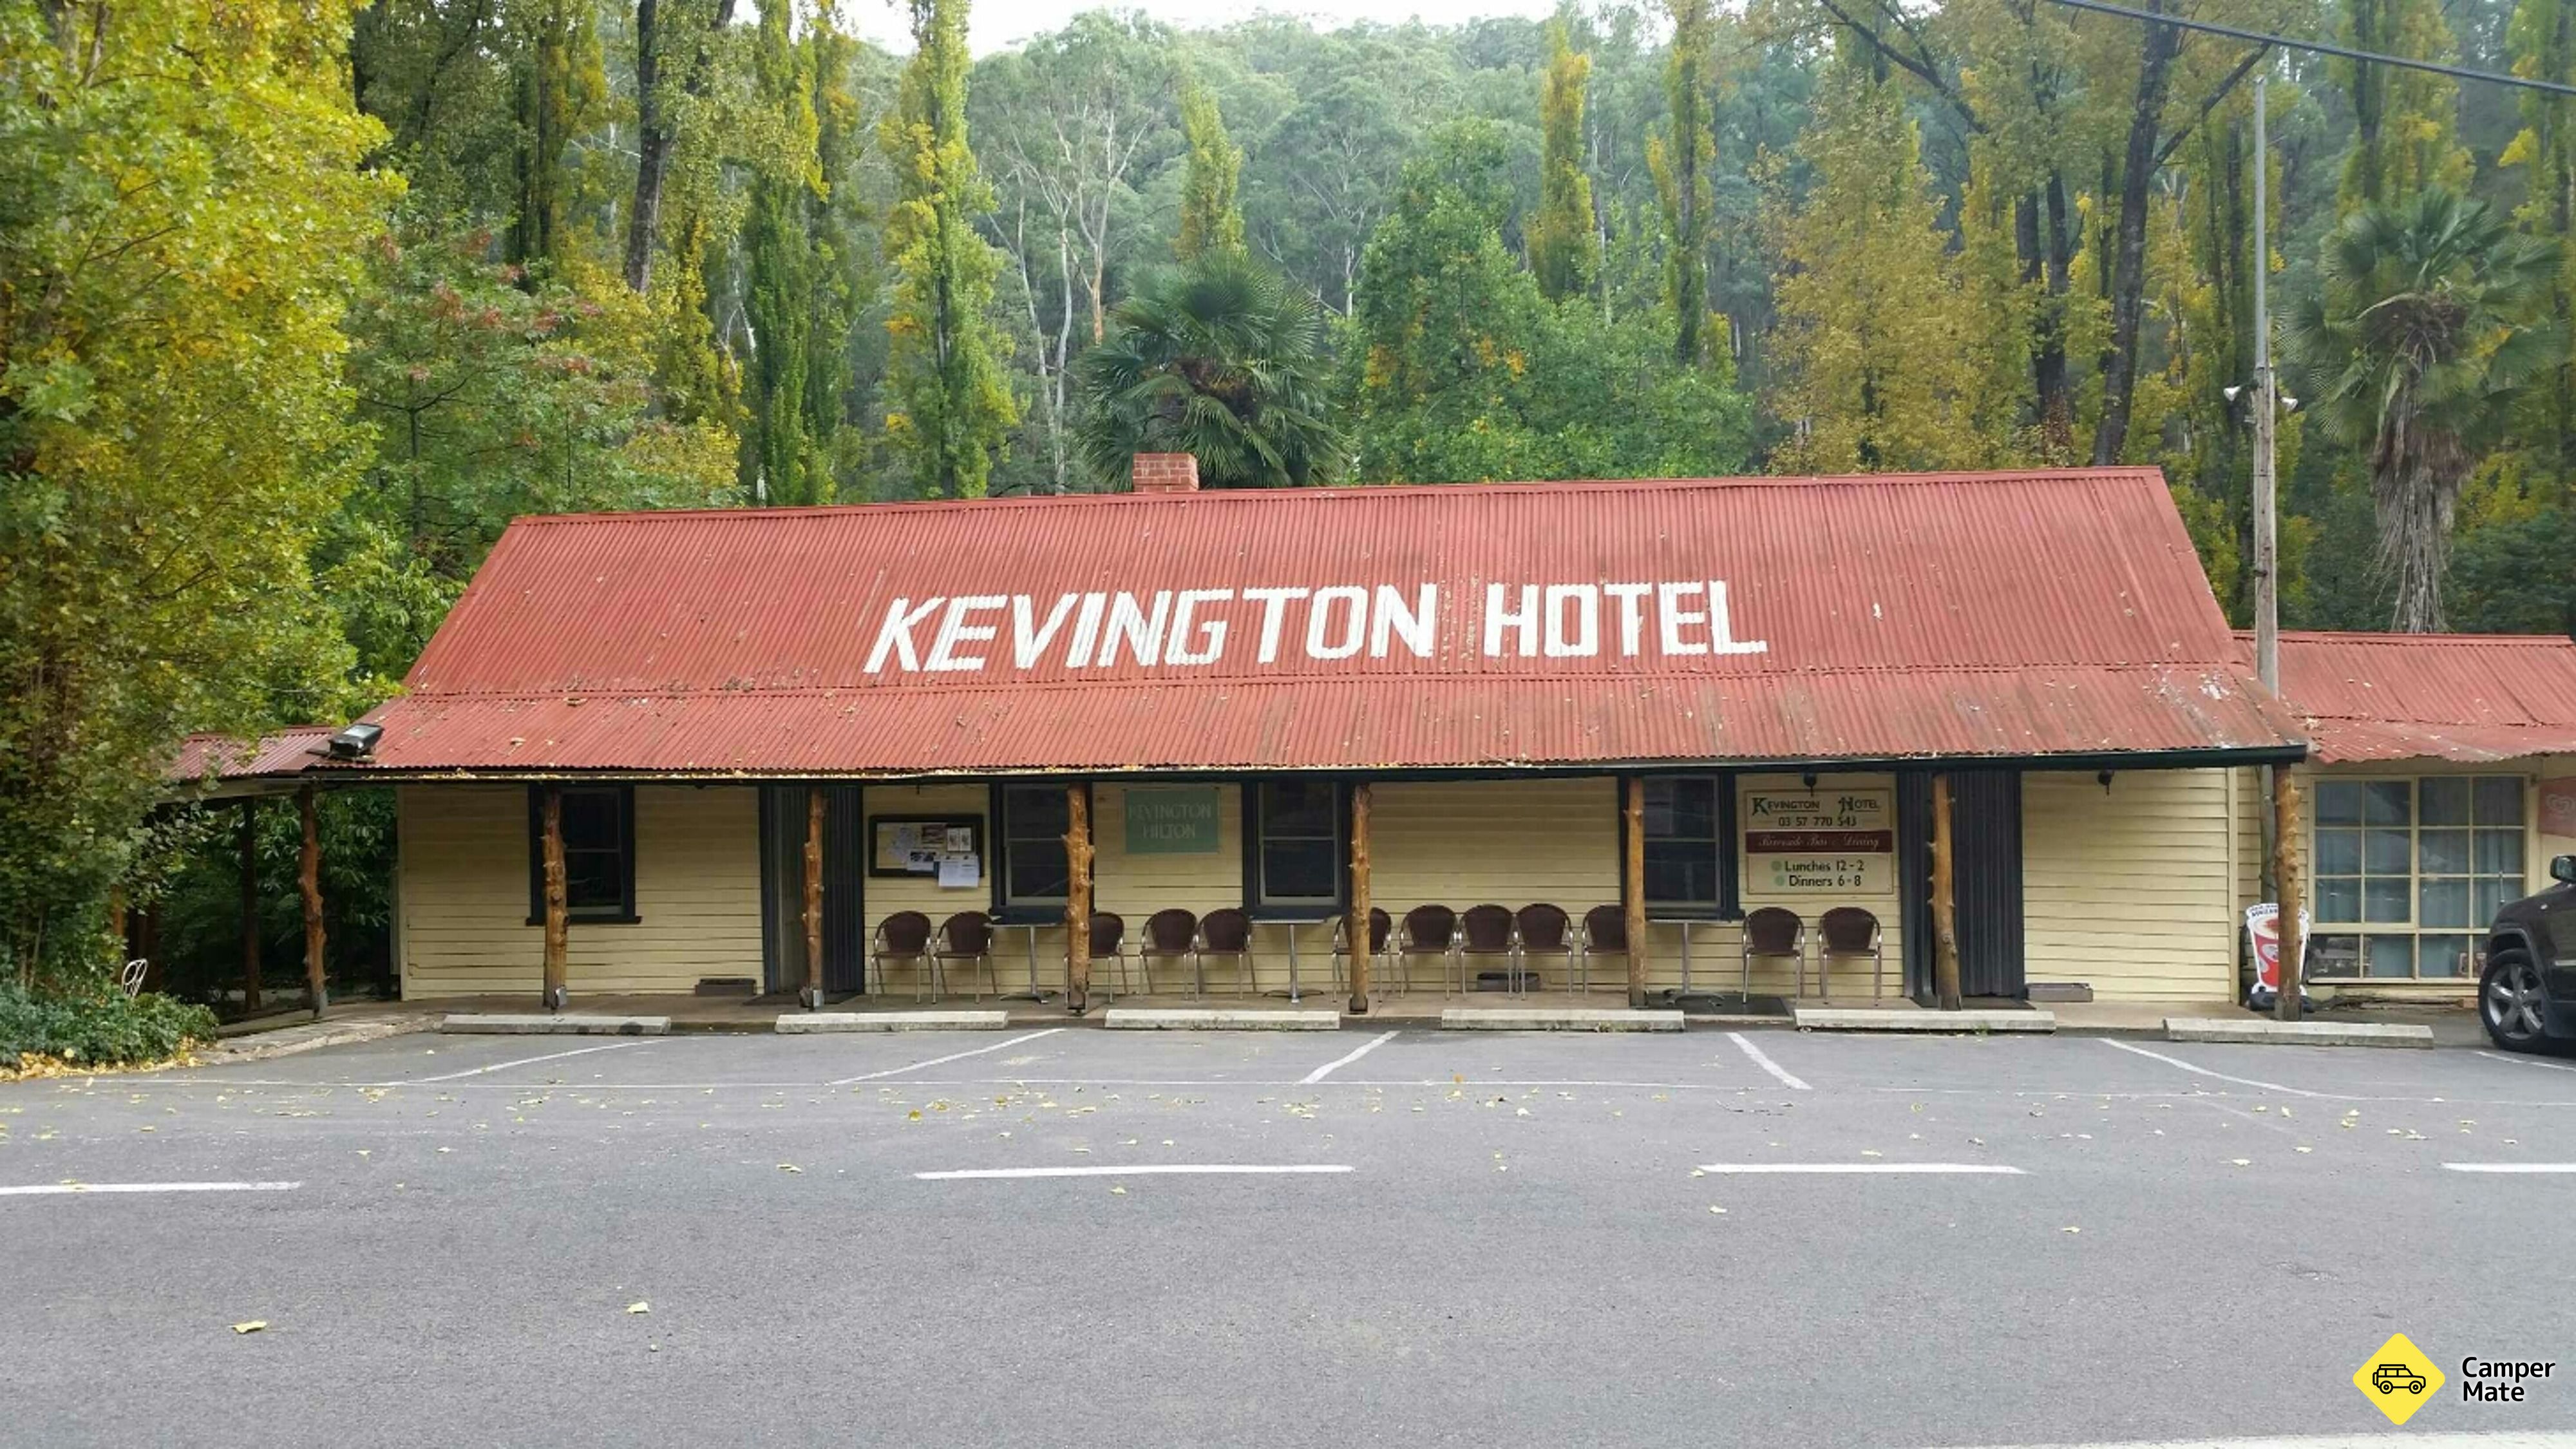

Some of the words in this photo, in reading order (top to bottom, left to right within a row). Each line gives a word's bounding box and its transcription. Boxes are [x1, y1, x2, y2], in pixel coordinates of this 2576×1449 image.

[864, 583, 1437, 674] KEVINGTON
[1484, 580, 1767, 659] HOTEL
[1752, 797, 1819, 816] KEVINGTON
[1838, 797, 1879, 814] HOTEL
[1778, 817, 1790, 827] 03
[1795, 817, 1808, 826] 57
[1814, 817, 1832, 826] 770
[1837, 816, 1857, 826] 543
[1142, 823, 1196, 839] HILTON
[1785, 860, 1831, 872] Lunches
[1789, 875, 1832, 887] Dinners
